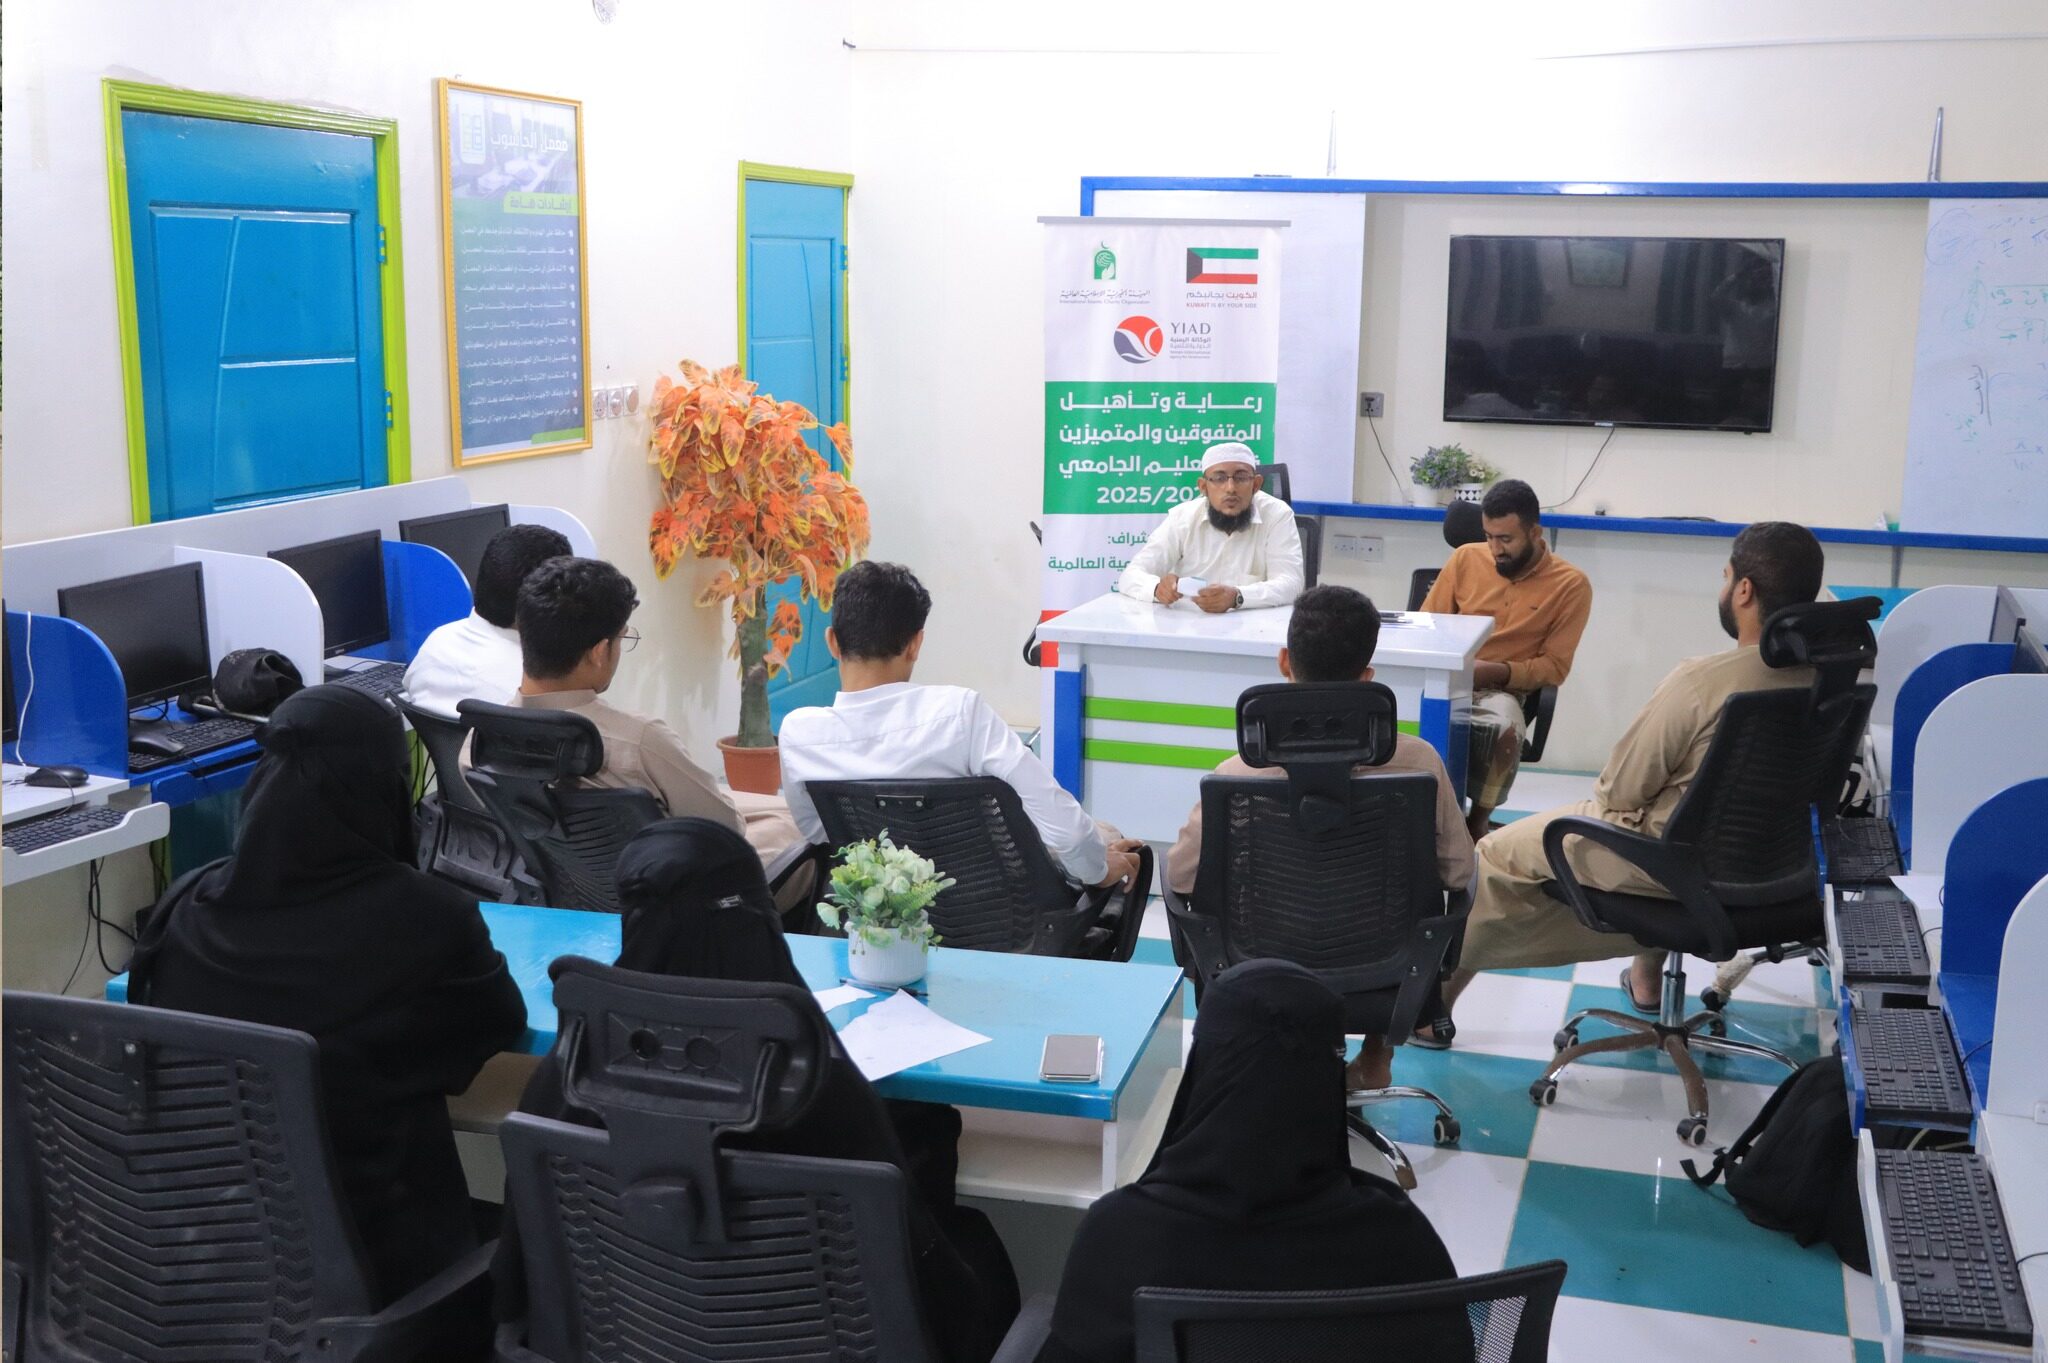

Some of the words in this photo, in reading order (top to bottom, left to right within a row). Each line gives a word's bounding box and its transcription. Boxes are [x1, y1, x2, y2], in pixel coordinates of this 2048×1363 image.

[1225, 290, 1258, 300] الكويت
[1171, 322, 1211, 335] YIAD
[1060, 389, 1171, 413] وتأهيل
[1175, 391, 1262, 413] رعاية
[1059, 424, 1161, 445] والمتميزين
[1165, 424, 1261, 445] المتفوقين
[1059, 455, 1141, 479] الجامعي
[1048, 556, 1105, 573] العالمية
